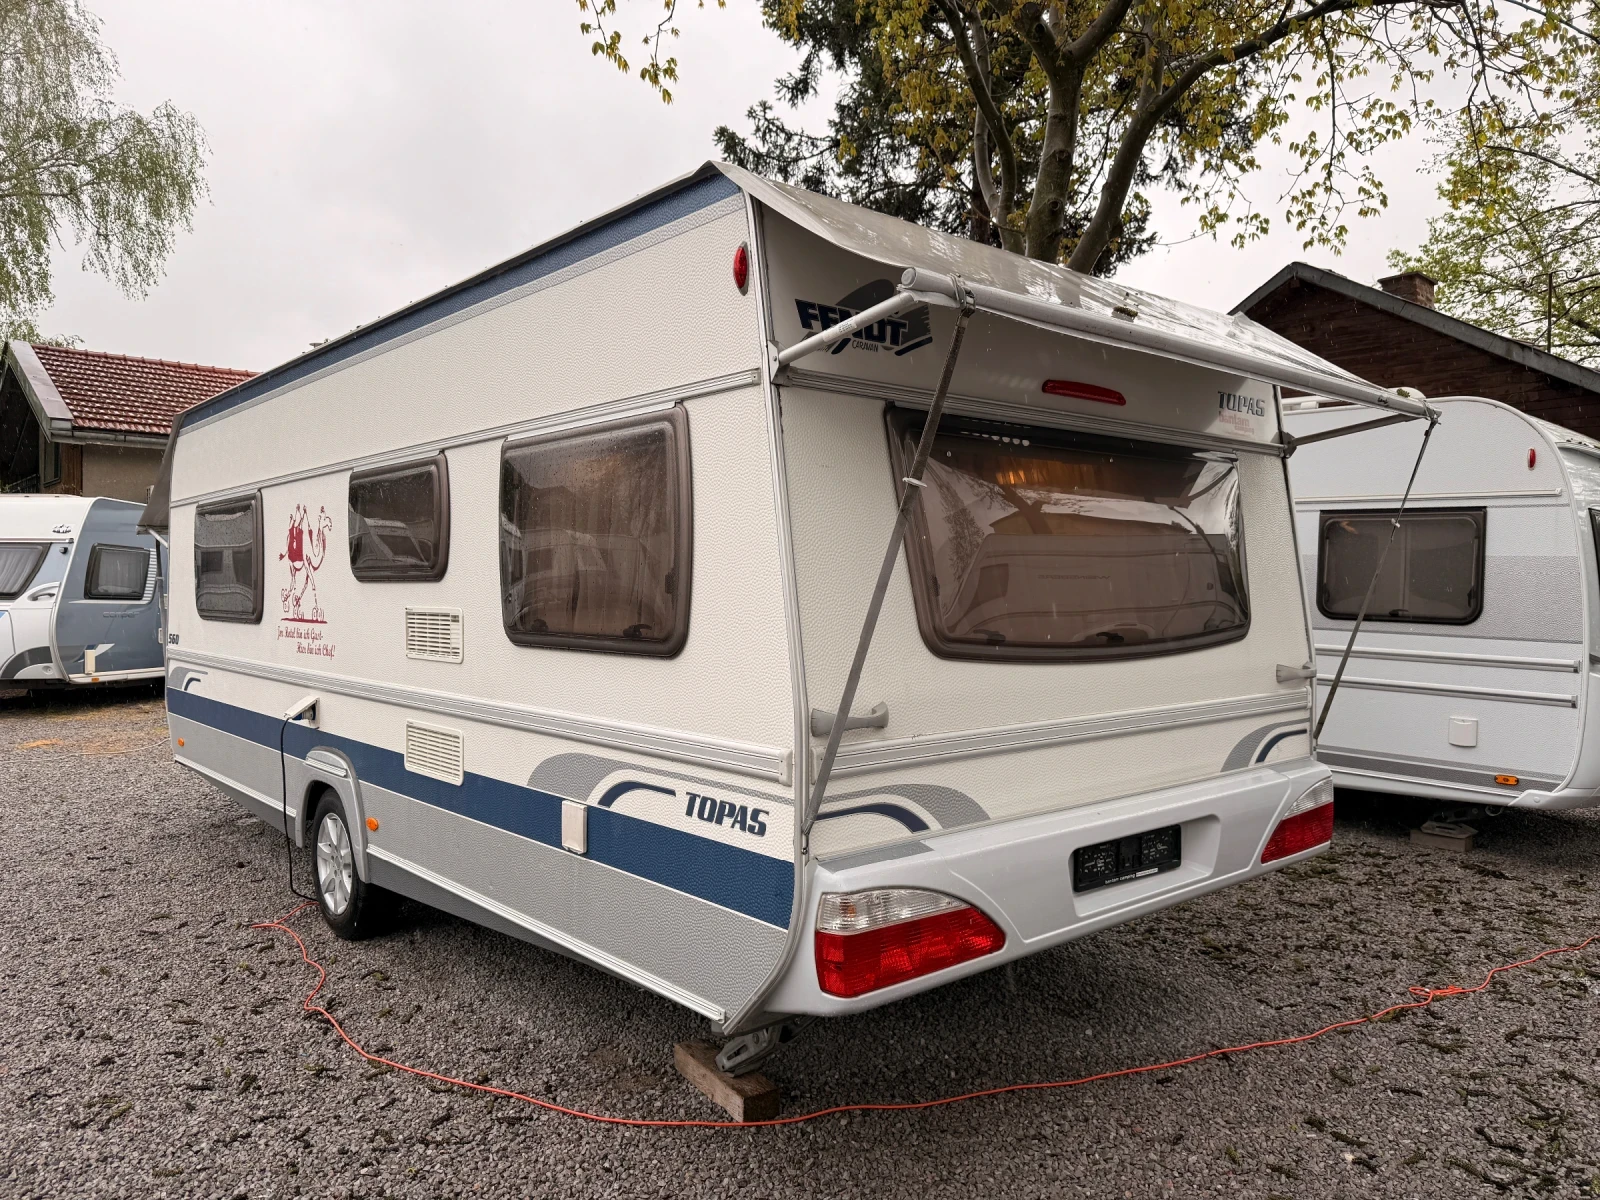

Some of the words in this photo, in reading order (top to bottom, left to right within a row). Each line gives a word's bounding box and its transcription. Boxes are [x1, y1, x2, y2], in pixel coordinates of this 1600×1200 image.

[851, 339, 879, 352] CARAVAN
[1218, 391, 1265, 417] TOPAS
[685, 791, 770, 837] TOPAS
